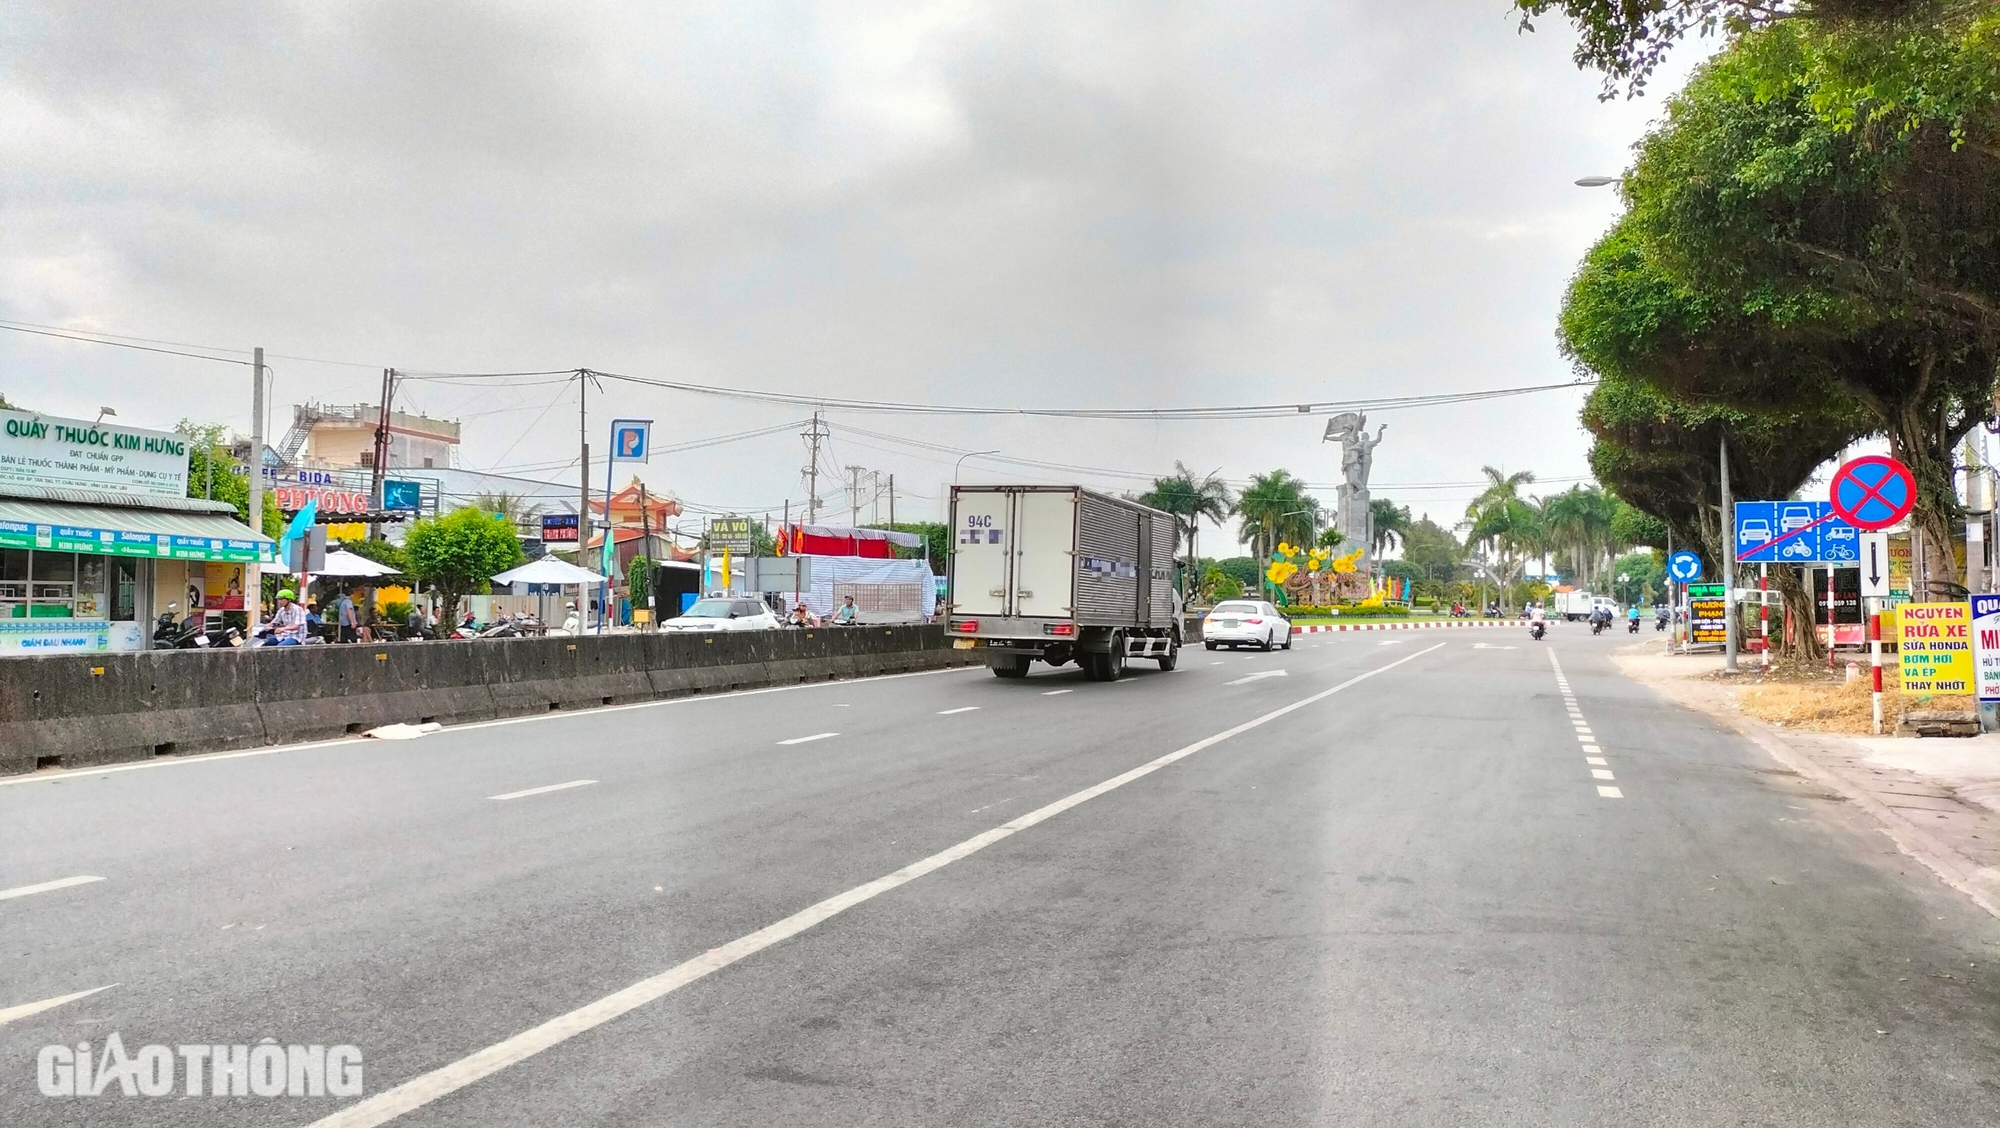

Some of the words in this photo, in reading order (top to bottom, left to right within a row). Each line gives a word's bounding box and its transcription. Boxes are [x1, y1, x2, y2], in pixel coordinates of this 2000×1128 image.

[55, 424, 109, 447] THUỐC
[114, 433, 140, 451] KIM
[145, 437, 184, 456] HƯNG
[69, 450, 83, 459] ĐẠT
[111, 454, 124, 462] GPP
[28, 457, 52, 468] THUỐC
[299, 471, 332, 484] BIDA
[713, 520, 729, 532] VÁ
[731, 519, 748, 532] VỎ
[968, 515, 992, 528] 94C
[121, 532, 151, 542] Salonpas
[58, 541, 72, 550] KIM
[228, 540, 254, 549] Salonpas
[176, 550, 188, 558] KIM
[1977, 599, 2000, 614] QU
[1904, 621, 1940, 637] RỬA
[1946, 625, 1968, 637] XE
[61, 638, 87, 646] NHANH
[1903, 639, 1926, 650] SỬA
[1930, 641, 1968, 650] HONDA
[1981, 629, 2000, 649] MI
[1904, 654, 1930, 664] BƠM
[1933, 653, 1952, 664] HƠI
[1982, 654, 1993, 666] HỦ
[1984, 669, 2000, 680] BÁN
[1905, 681, 1932, 690] THAY
[1936, 679, 1966, 690] NHỚT
